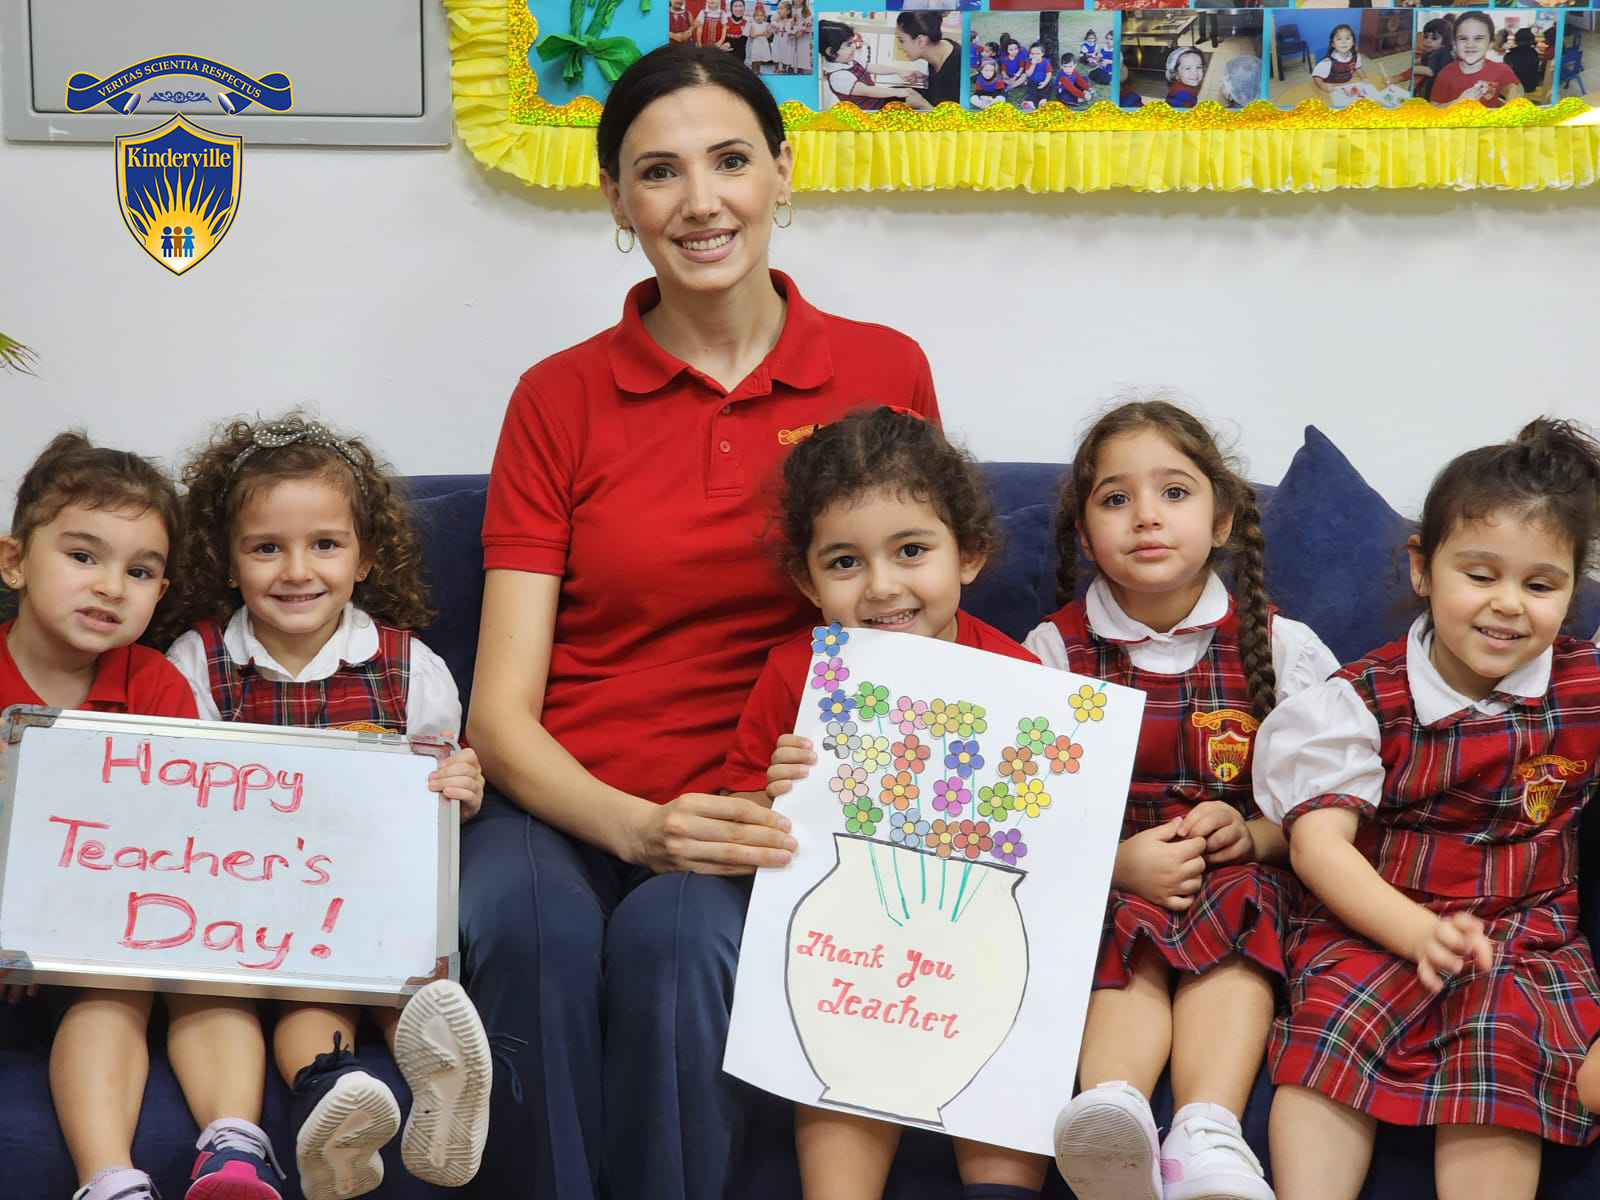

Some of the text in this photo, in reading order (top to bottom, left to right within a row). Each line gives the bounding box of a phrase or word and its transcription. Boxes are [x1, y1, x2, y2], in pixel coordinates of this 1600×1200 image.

[102, 736, 303, 812] Happy
[50, 815, 333, 886] Teacher's
[796, 930, 885, 968] Thank
[817, 977, 960, 1039] Teacher
